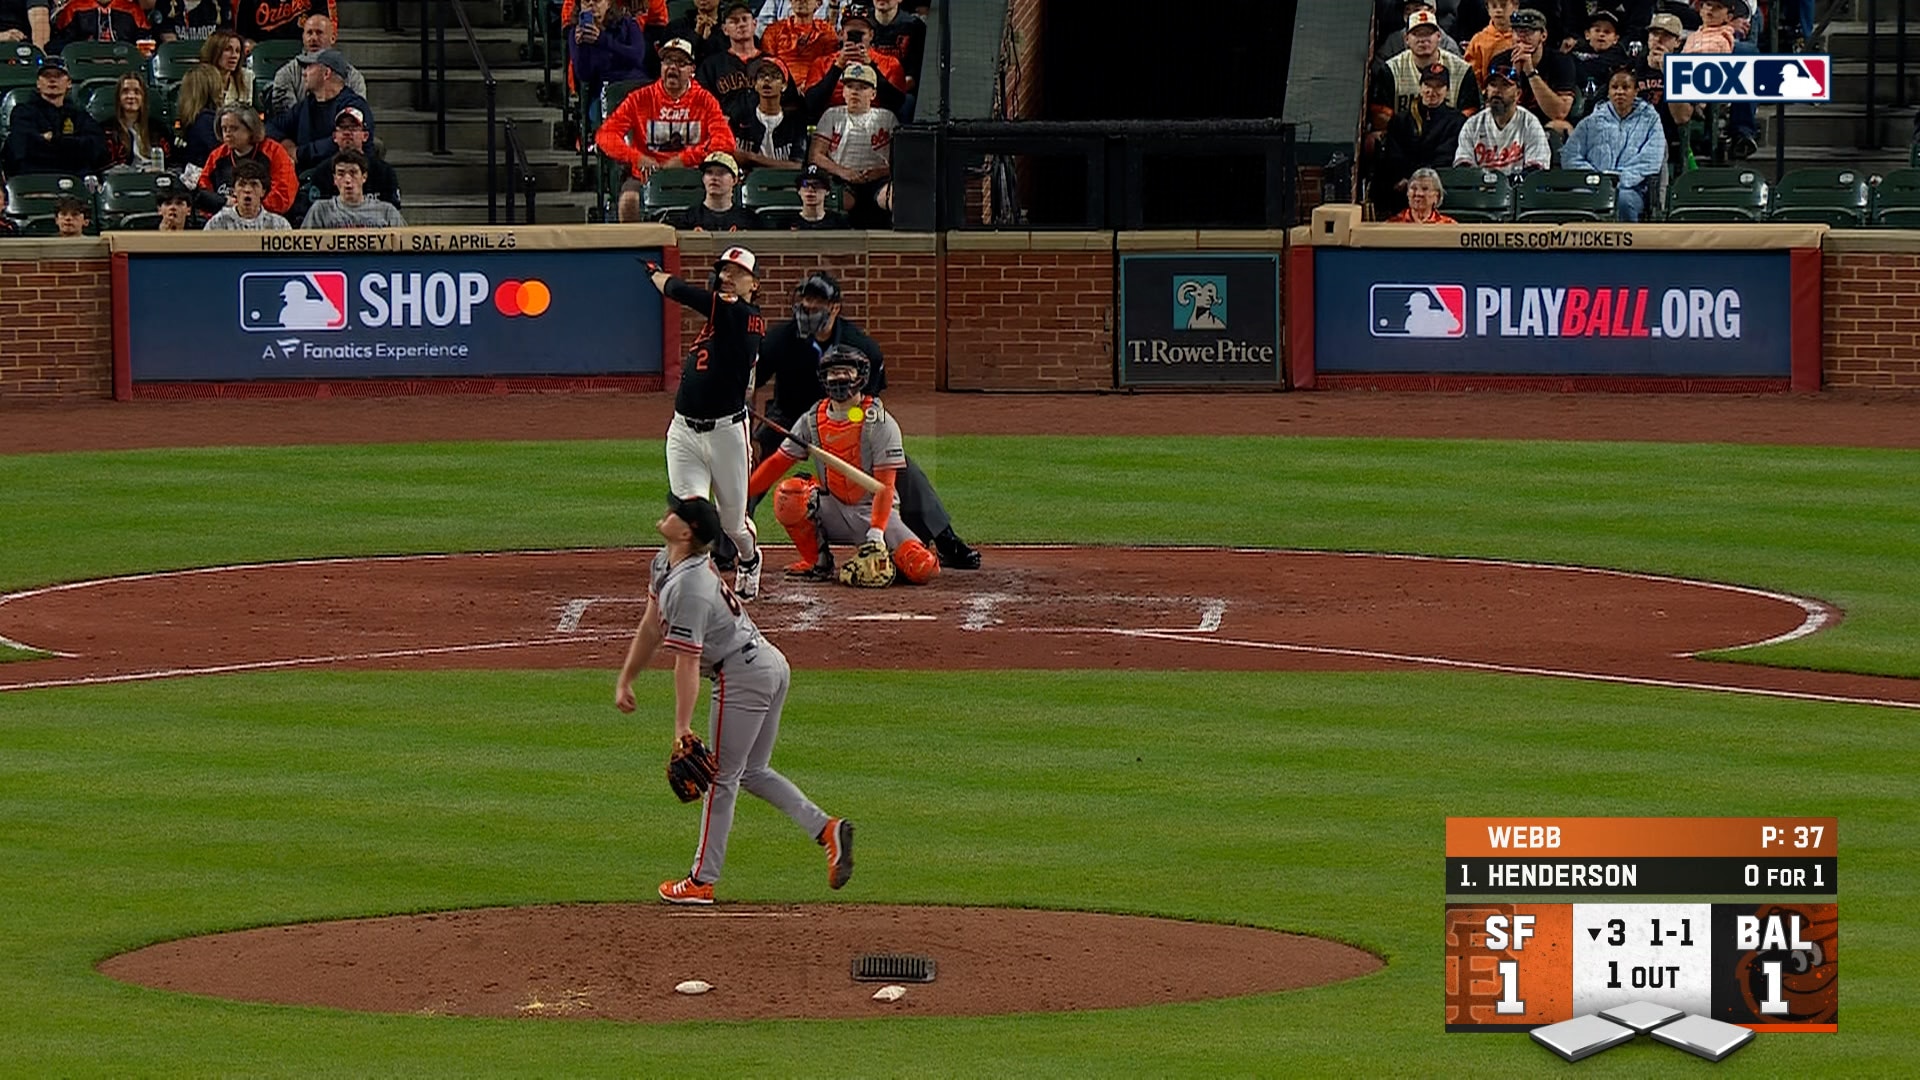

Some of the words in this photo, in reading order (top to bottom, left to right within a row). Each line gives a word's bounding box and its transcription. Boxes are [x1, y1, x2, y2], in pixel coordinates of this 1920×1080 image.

[261, 235, 322, 250] HOCKEY
[326, 234, 386, 250] JERSEY
[411, 234, 444, 250] SAT,
[449, 233, 494, 249] APRIL
[1460, 231, 1633, 247] ORIOLES.COM/TICKETS
[359, 272, 489, 327] SHOP
[1476, 287, 1741, 338] PLAYBALL.ORG
[262, 345, 276, 359] A
[303, 343, 373, 359] Fanatics
[375, 343, 469, 360] Experience
[696, 349, 709, 371] 2
